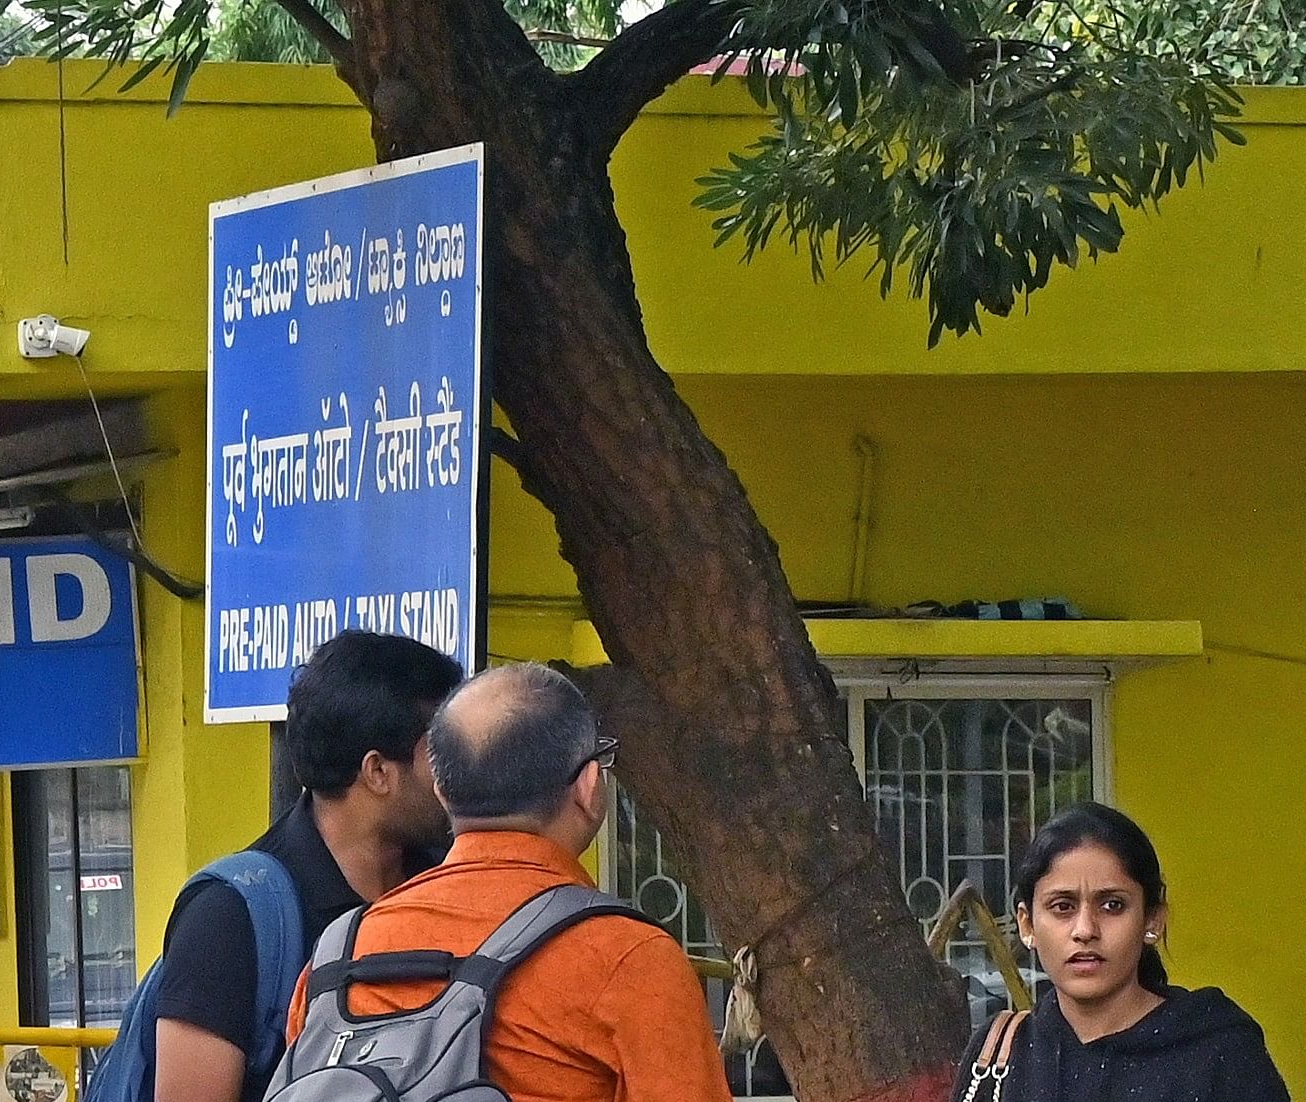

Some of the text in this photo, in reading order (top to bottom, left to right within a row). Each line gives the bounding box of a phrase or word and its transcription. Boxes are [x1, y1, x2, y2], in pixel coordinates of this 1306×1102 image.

[223, 408, 249, 547] पूर्व
[251, 433, 310, 543] भुगतान
[311, 391, 353, 505] ऑटो
[374, 379, 424, 496] टैक्सी
[219, 604, 289, 673] PRE-PAID
